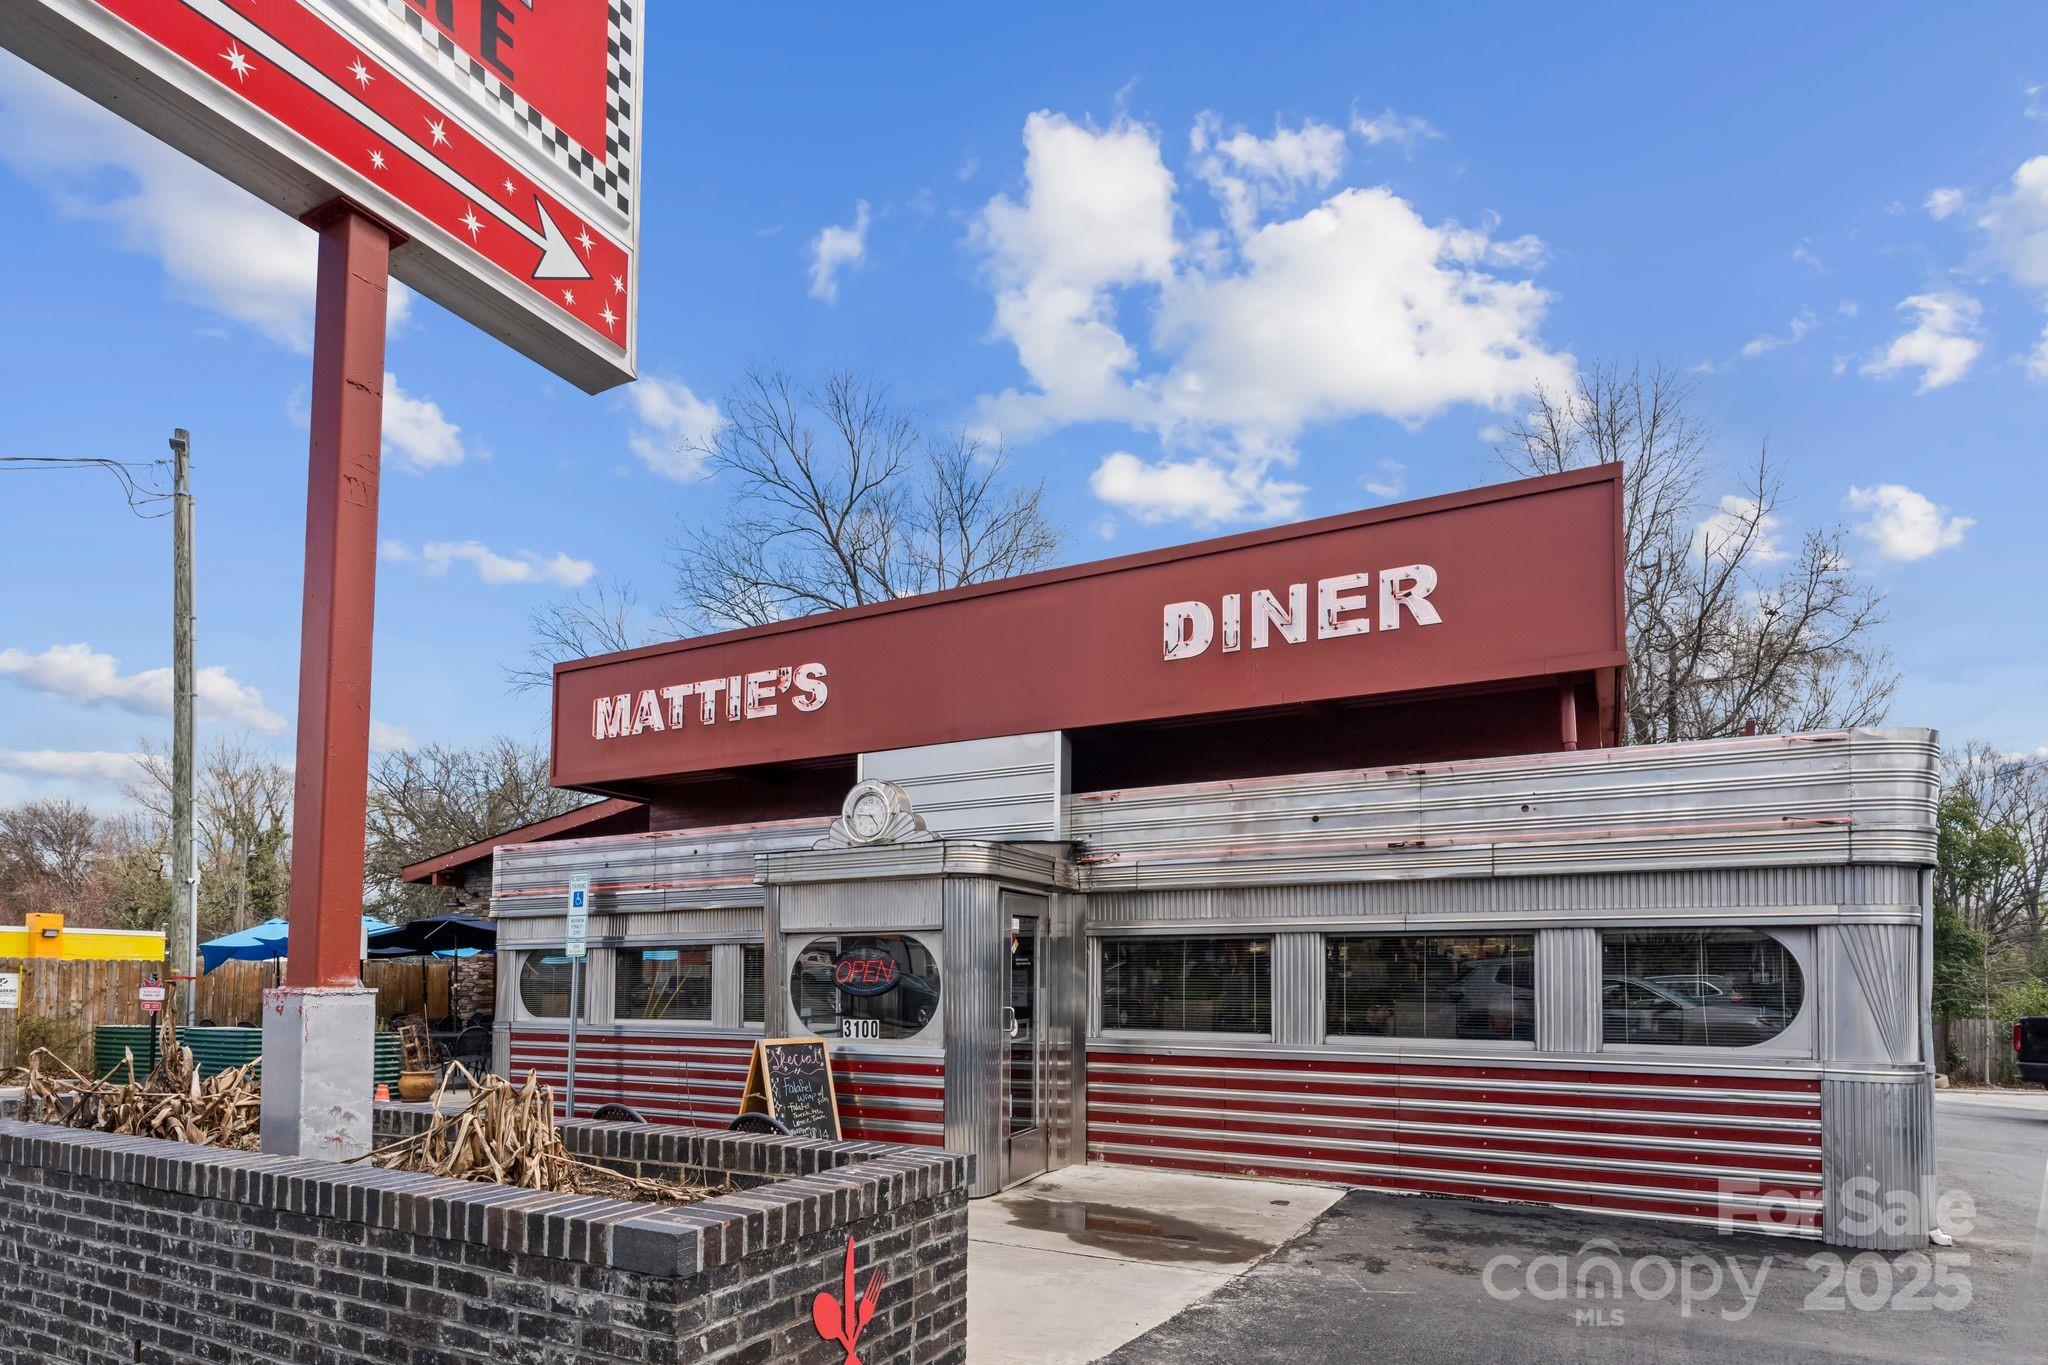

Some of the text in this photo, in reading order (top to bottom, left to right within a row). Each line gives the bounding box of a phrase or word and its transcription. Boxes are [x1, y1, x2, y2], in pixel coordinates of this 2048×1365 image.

[592, 564, 1442, 740] MATTIE'S DINER
[835, 959, 896, 984] OPEN
[844, 1020, 878, 1038] 3100
[768, 1047, 821, 1070] Special
